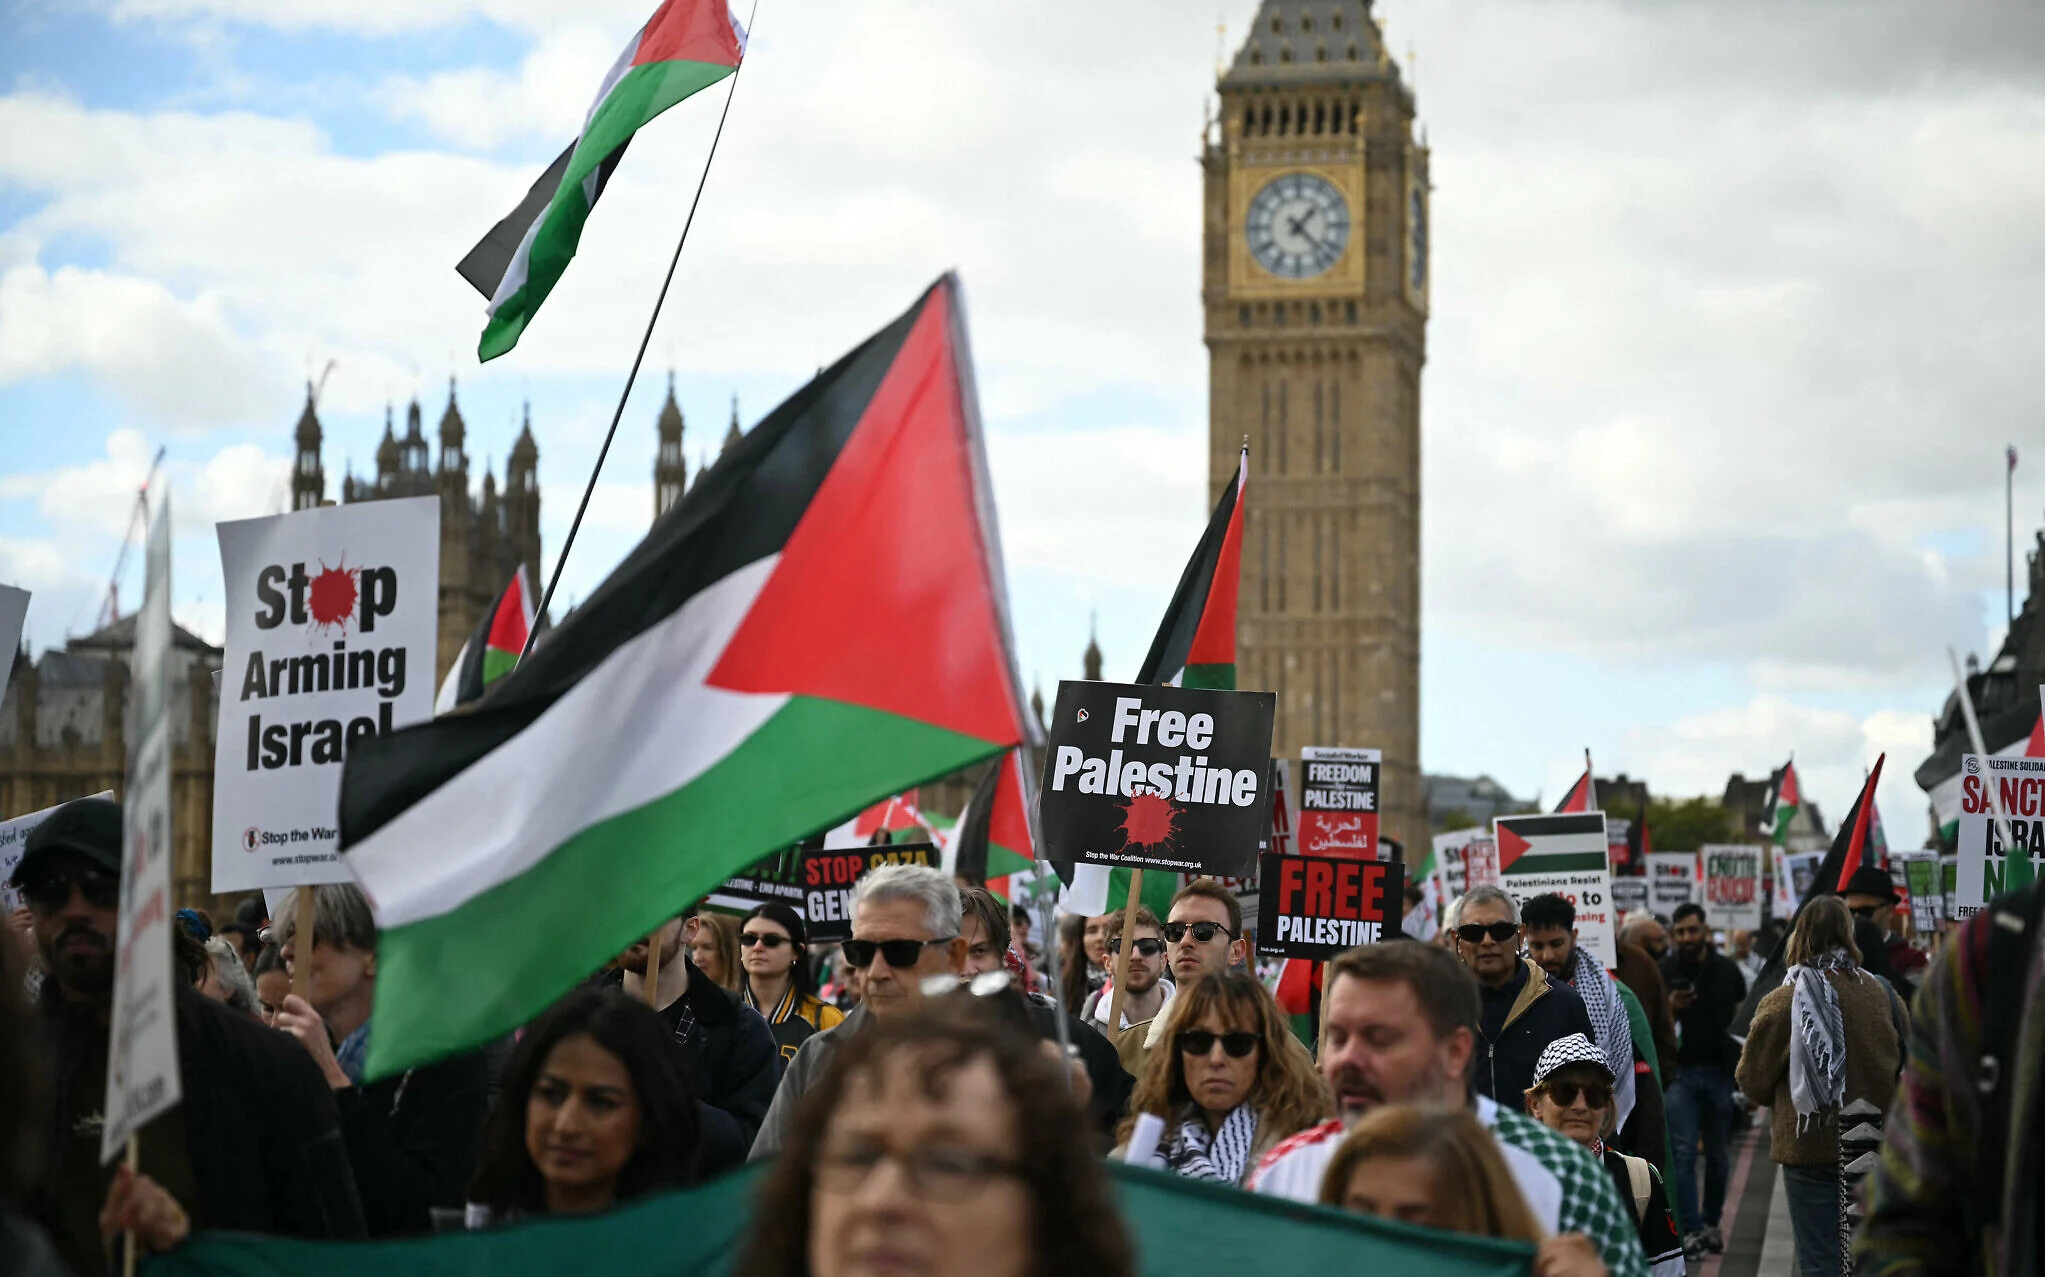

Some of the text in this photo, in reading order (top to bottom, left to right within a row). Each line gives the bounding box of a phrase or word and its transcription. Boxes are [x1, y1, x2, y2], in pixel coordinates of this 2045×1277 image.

[240, 641, 406, 701] Arming
[1111, 697, 1214, 750] Free
[1309, 763, 1372, 783] FREEDOM
[1987, 760, 2018, 770] ALESTINE
[1052, 745, 1258, 807] Palestine
[1305, 790, 1375, 810] PALESTINE
[262, 827, 337, 846] Stop the War
[1316, 815, 1361, 838] الحرية
[1309, 835, 1367, 850] لفلسطين
[1086, 851, 1202, 869] Stop the War Coalition www.stopwar.org.uk
[805, 856, 863, 886] STOP
[1279, 859, 1386, 922] FREE
[1506, 876, 1601, 888] Palestinians Resist
[807, 890, 853, 922] GEN
[1583, 891, 1602, 906] to
[1276, 915, 1383, 946] PALESTINE
